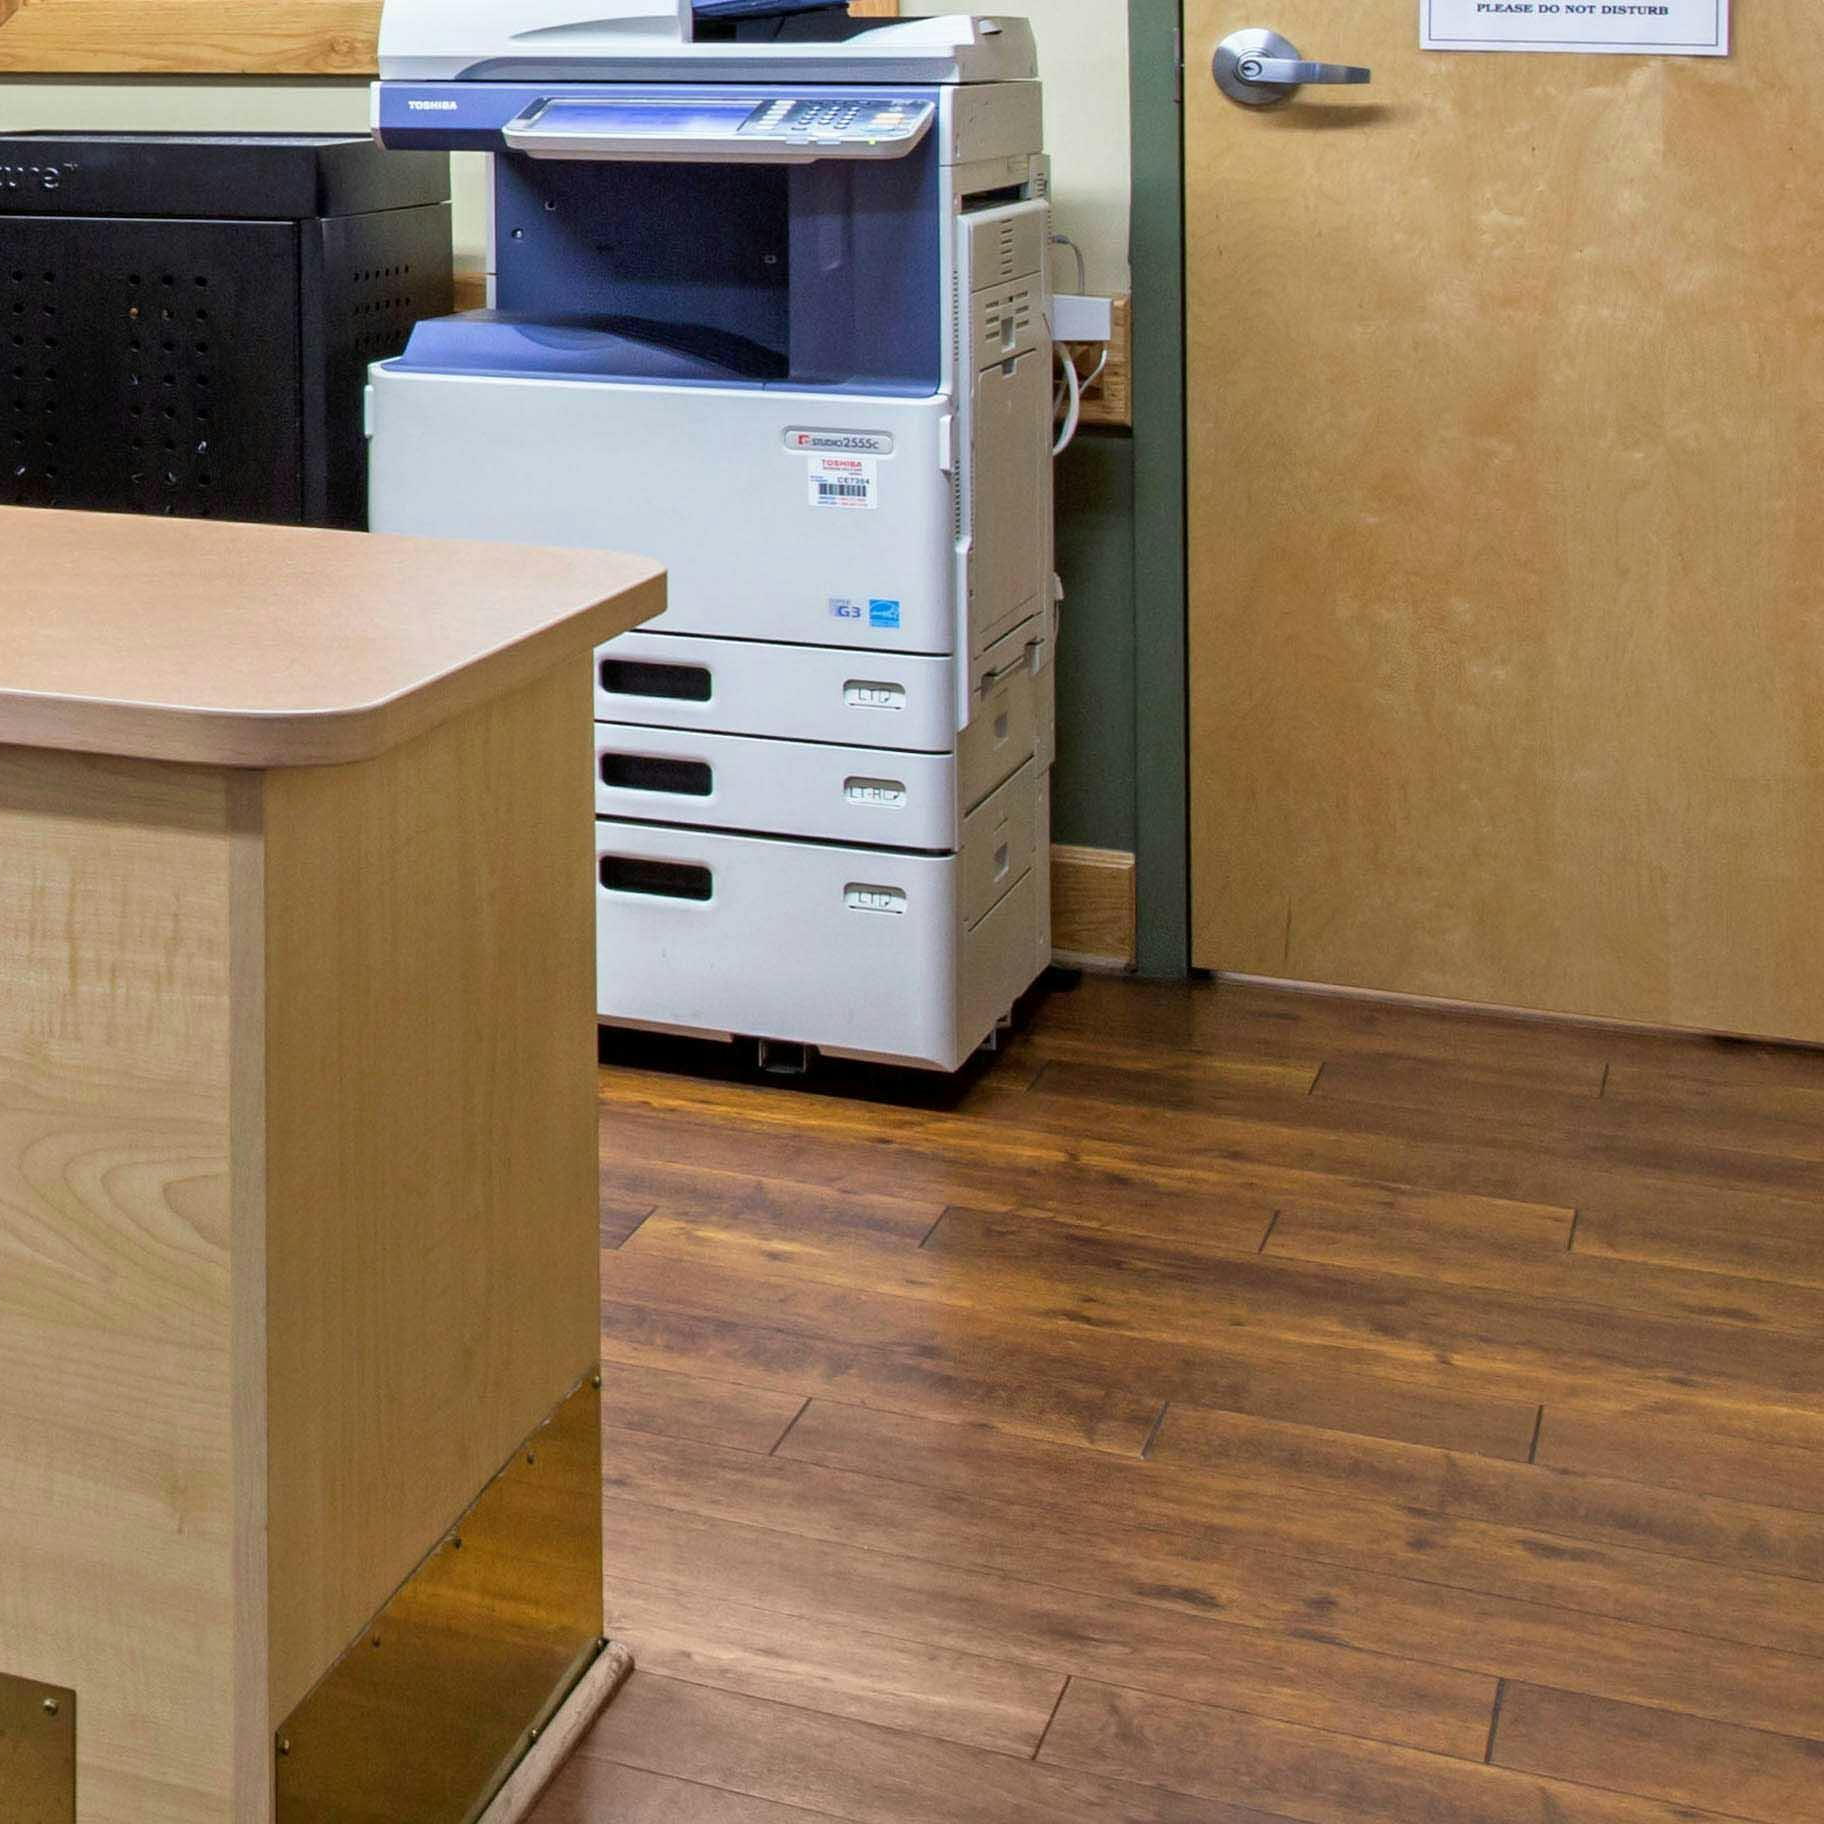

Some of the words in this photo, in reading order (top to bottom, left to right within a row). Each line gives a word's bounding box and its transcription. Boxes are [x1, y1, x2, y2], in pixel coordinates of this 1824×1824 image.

[1476, 3, 1533, 14] PLEASE
[1539, 4, 1560, 14] DO
[1565, 4, 1596, 15] NOT
[1602, 5, 1669, 16] DISTURB
[408, 101, 457, 110] TOSHIBA
[822, 459, 862, 467] TOSHIBA
